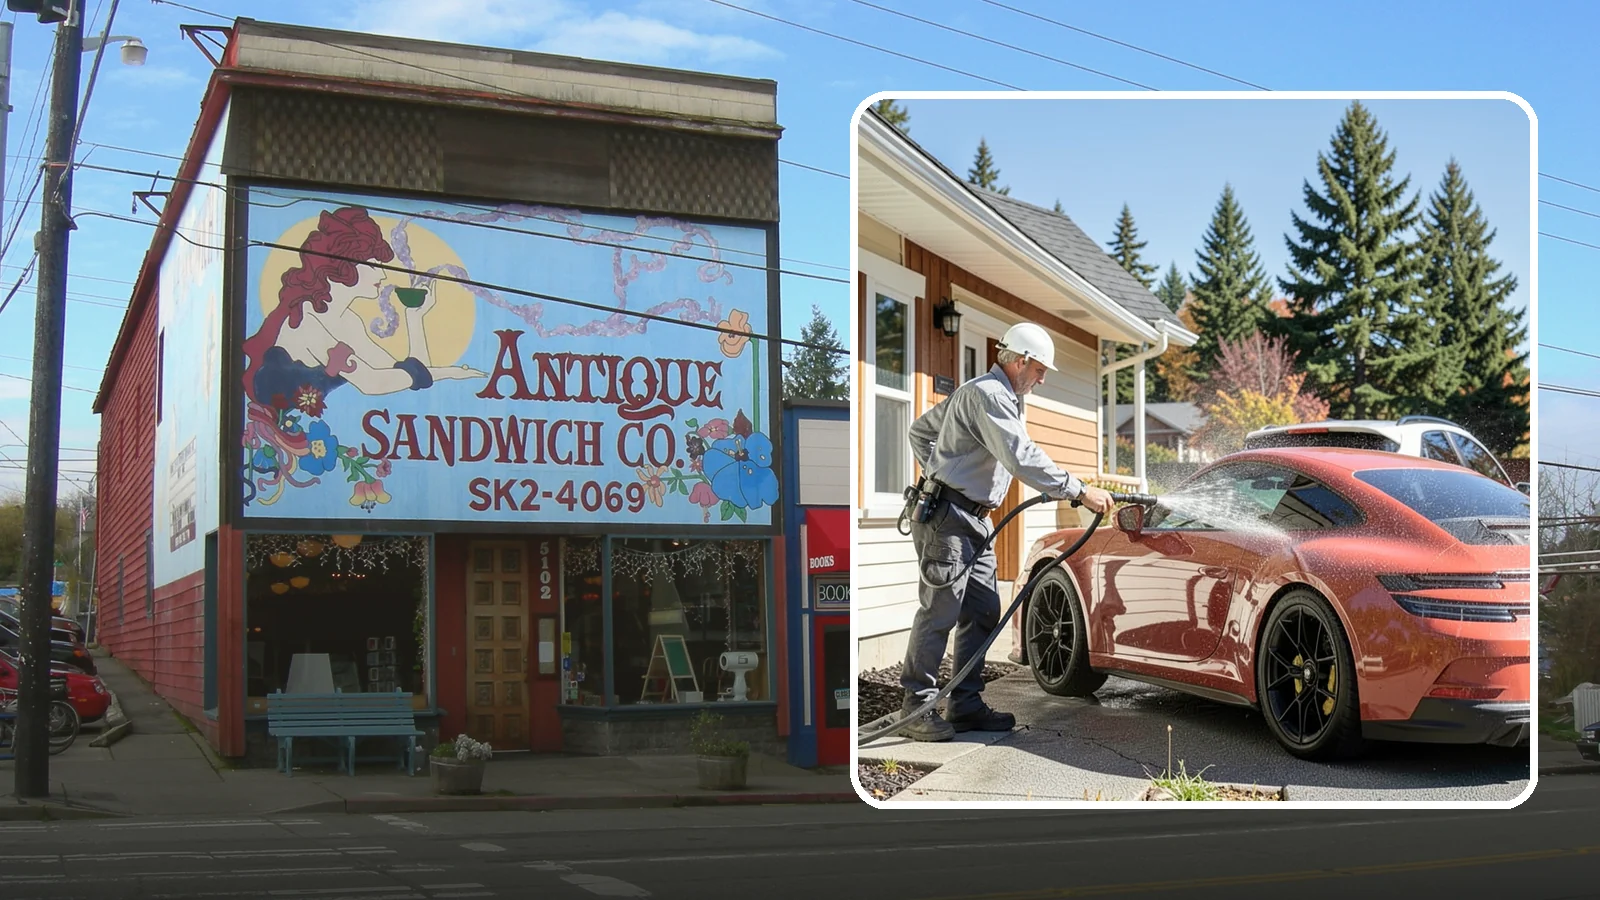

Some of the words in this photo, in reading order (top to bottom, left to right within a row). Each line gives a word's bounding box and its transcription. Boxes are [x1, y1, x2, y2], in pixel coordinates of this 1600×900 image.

[475, 328, 724, 421] ANTIQUE
[361, 408, 605, 467] SANDWICH
[617, 422, 685, 468] CO.
[469, 477, 646, 514] SK2-4069
[539, 541, 552, 600] 5102
[809, 554, 835, 569] BOOKS
